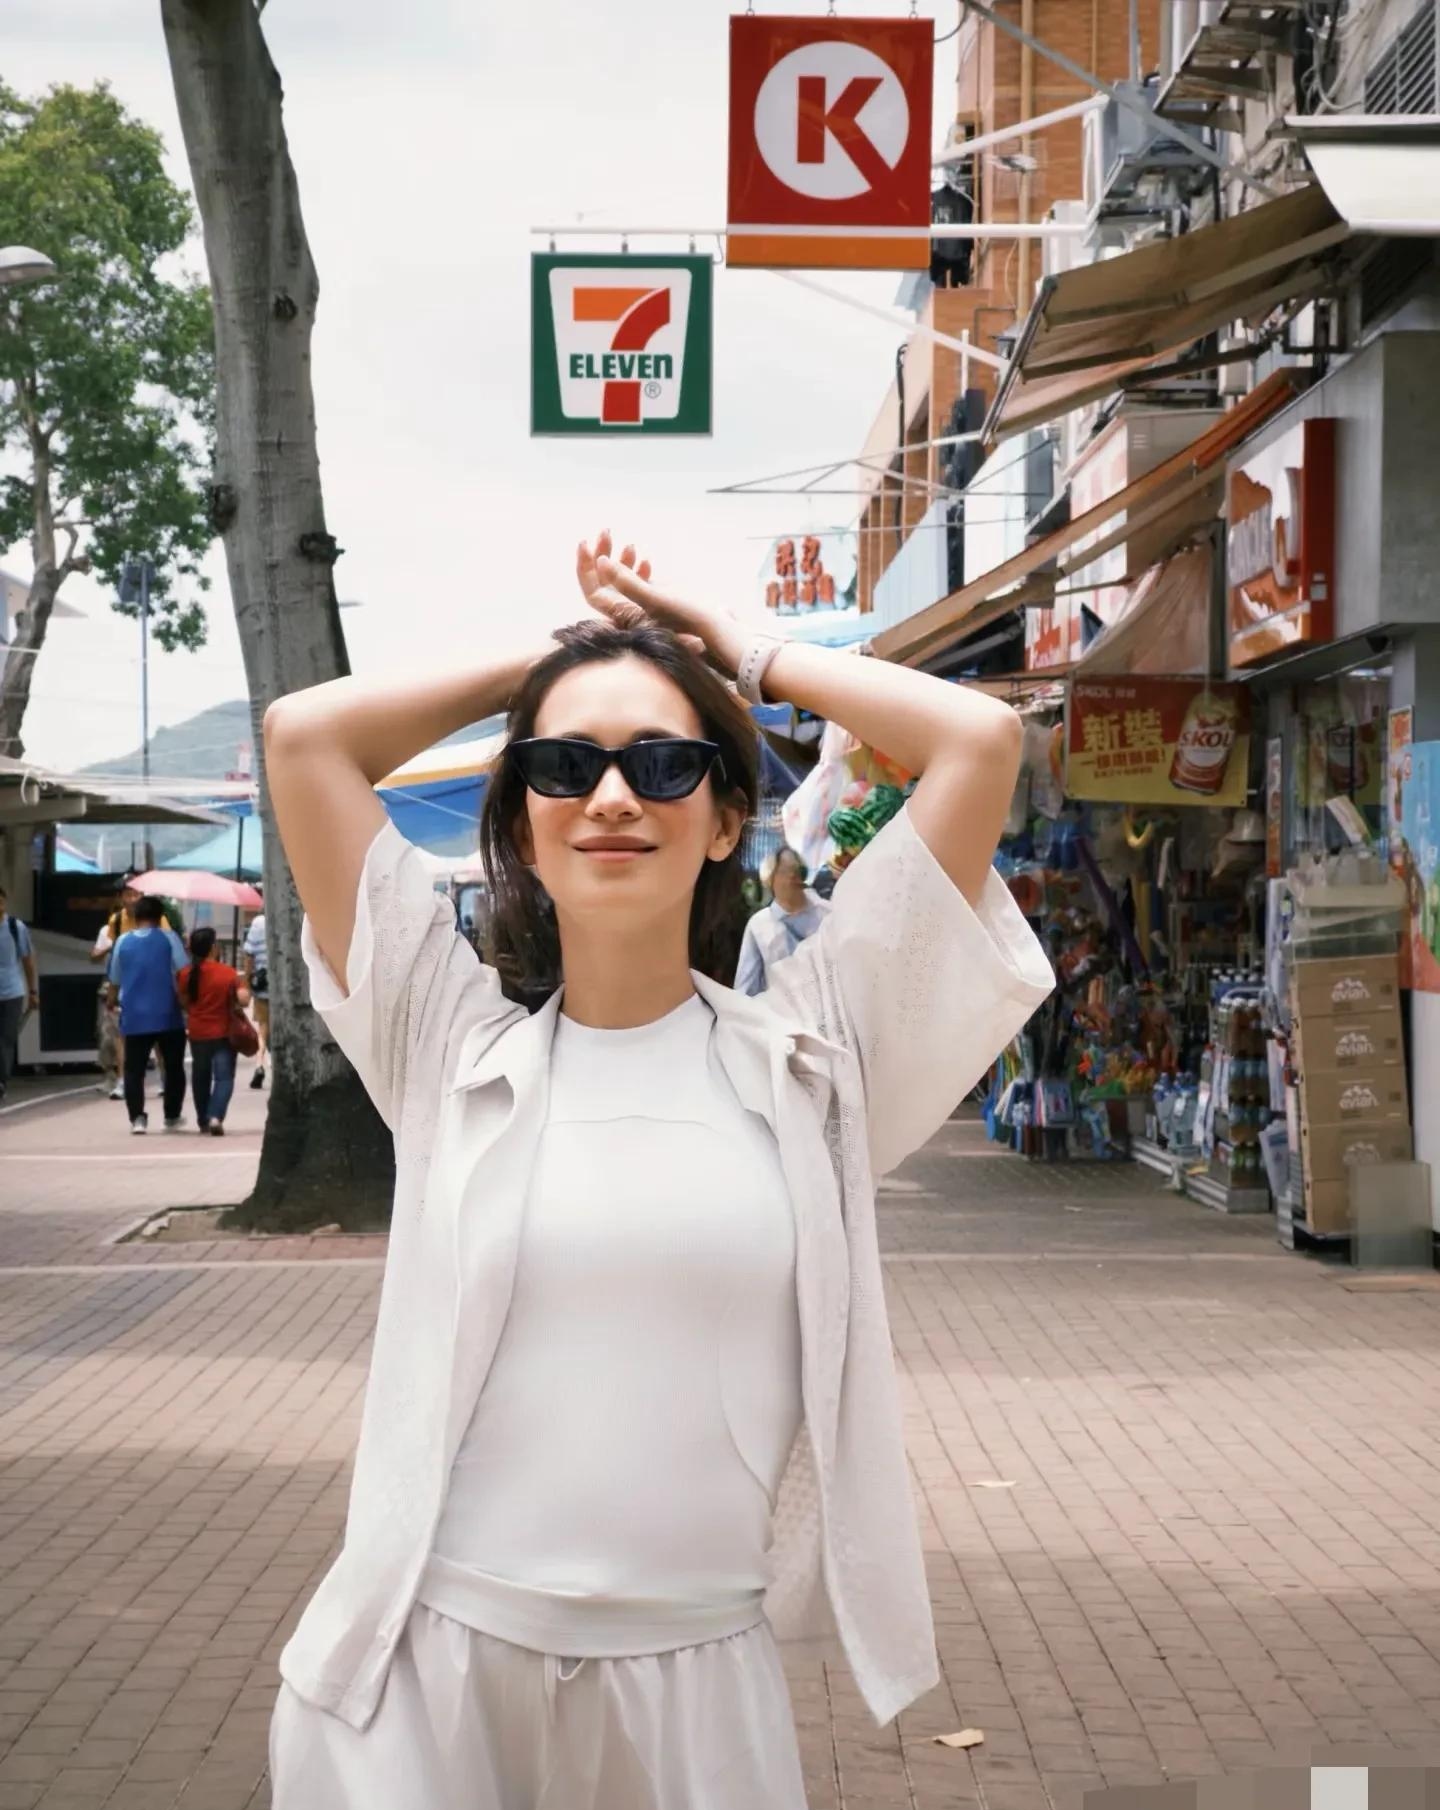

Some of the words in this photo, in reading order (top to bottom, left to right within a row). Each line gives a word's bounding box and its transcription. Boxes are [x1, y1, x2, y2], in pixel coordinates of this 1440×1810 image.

[797, 75, 893, 190] K
[573, 287, 671, 424] 7
[1181, 730, 1231, 748] SKOL
[1331, 987, 1371, 1002] evian
[1335, 1041, 1374, 1056] evian
[1339, 1094, 1378, 1109] evian
